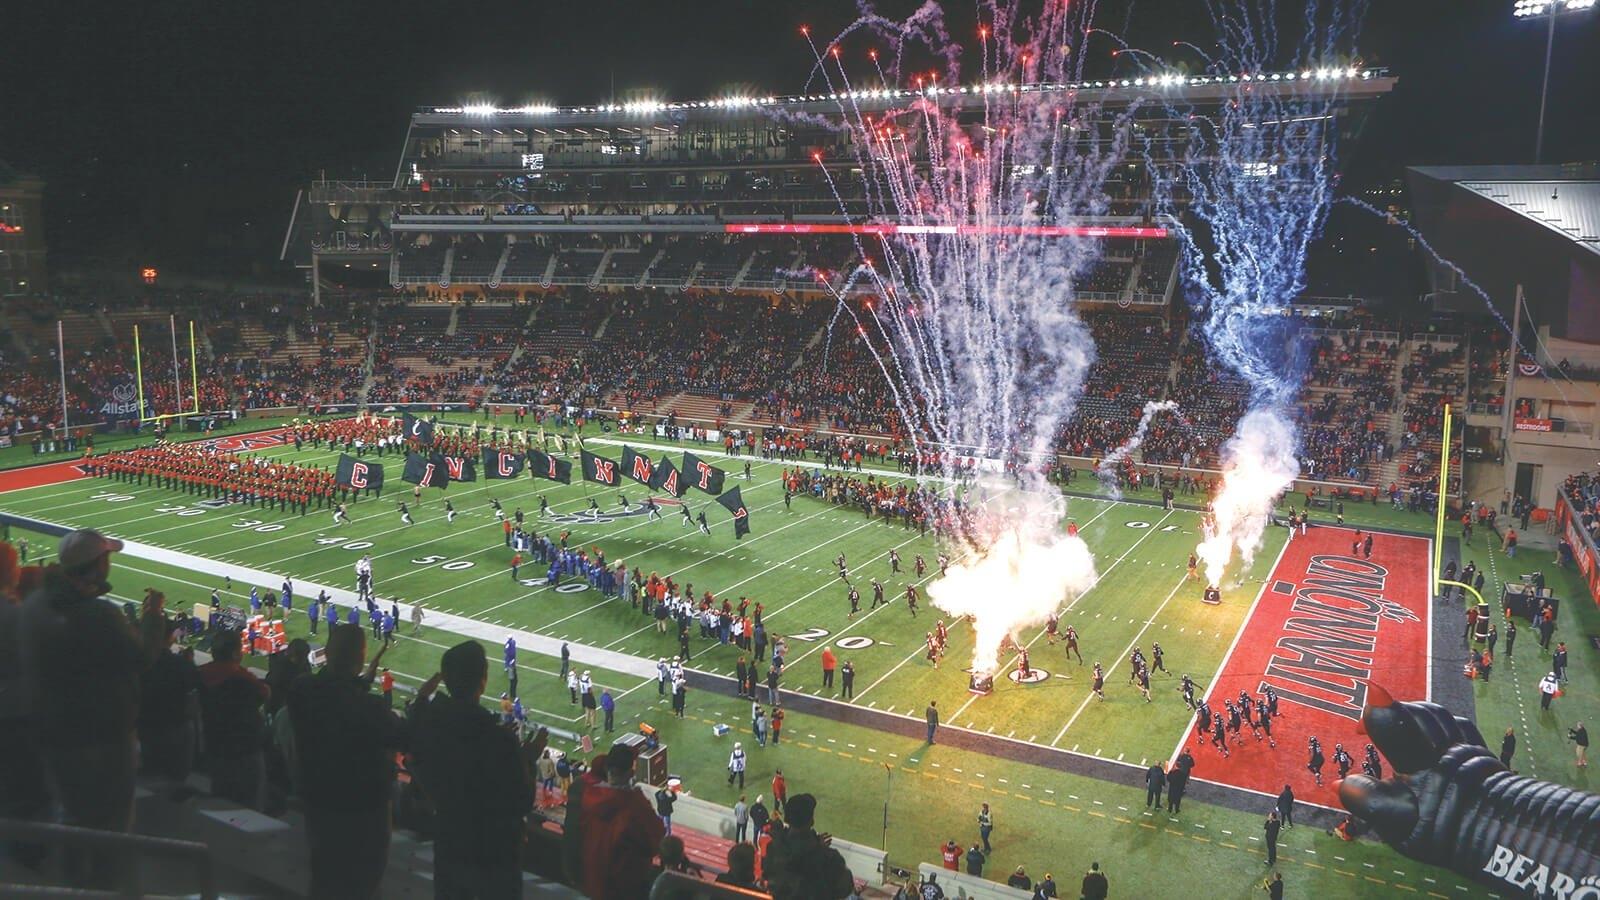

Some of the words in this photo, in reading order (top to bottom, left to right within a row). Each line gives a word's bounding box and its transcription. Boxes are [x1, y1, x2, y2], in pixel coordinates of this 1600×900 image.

[100, 399, 149, 415] Allstate
[411, 555, 475, 570] 50
[786, 628, 875, 649] 20
